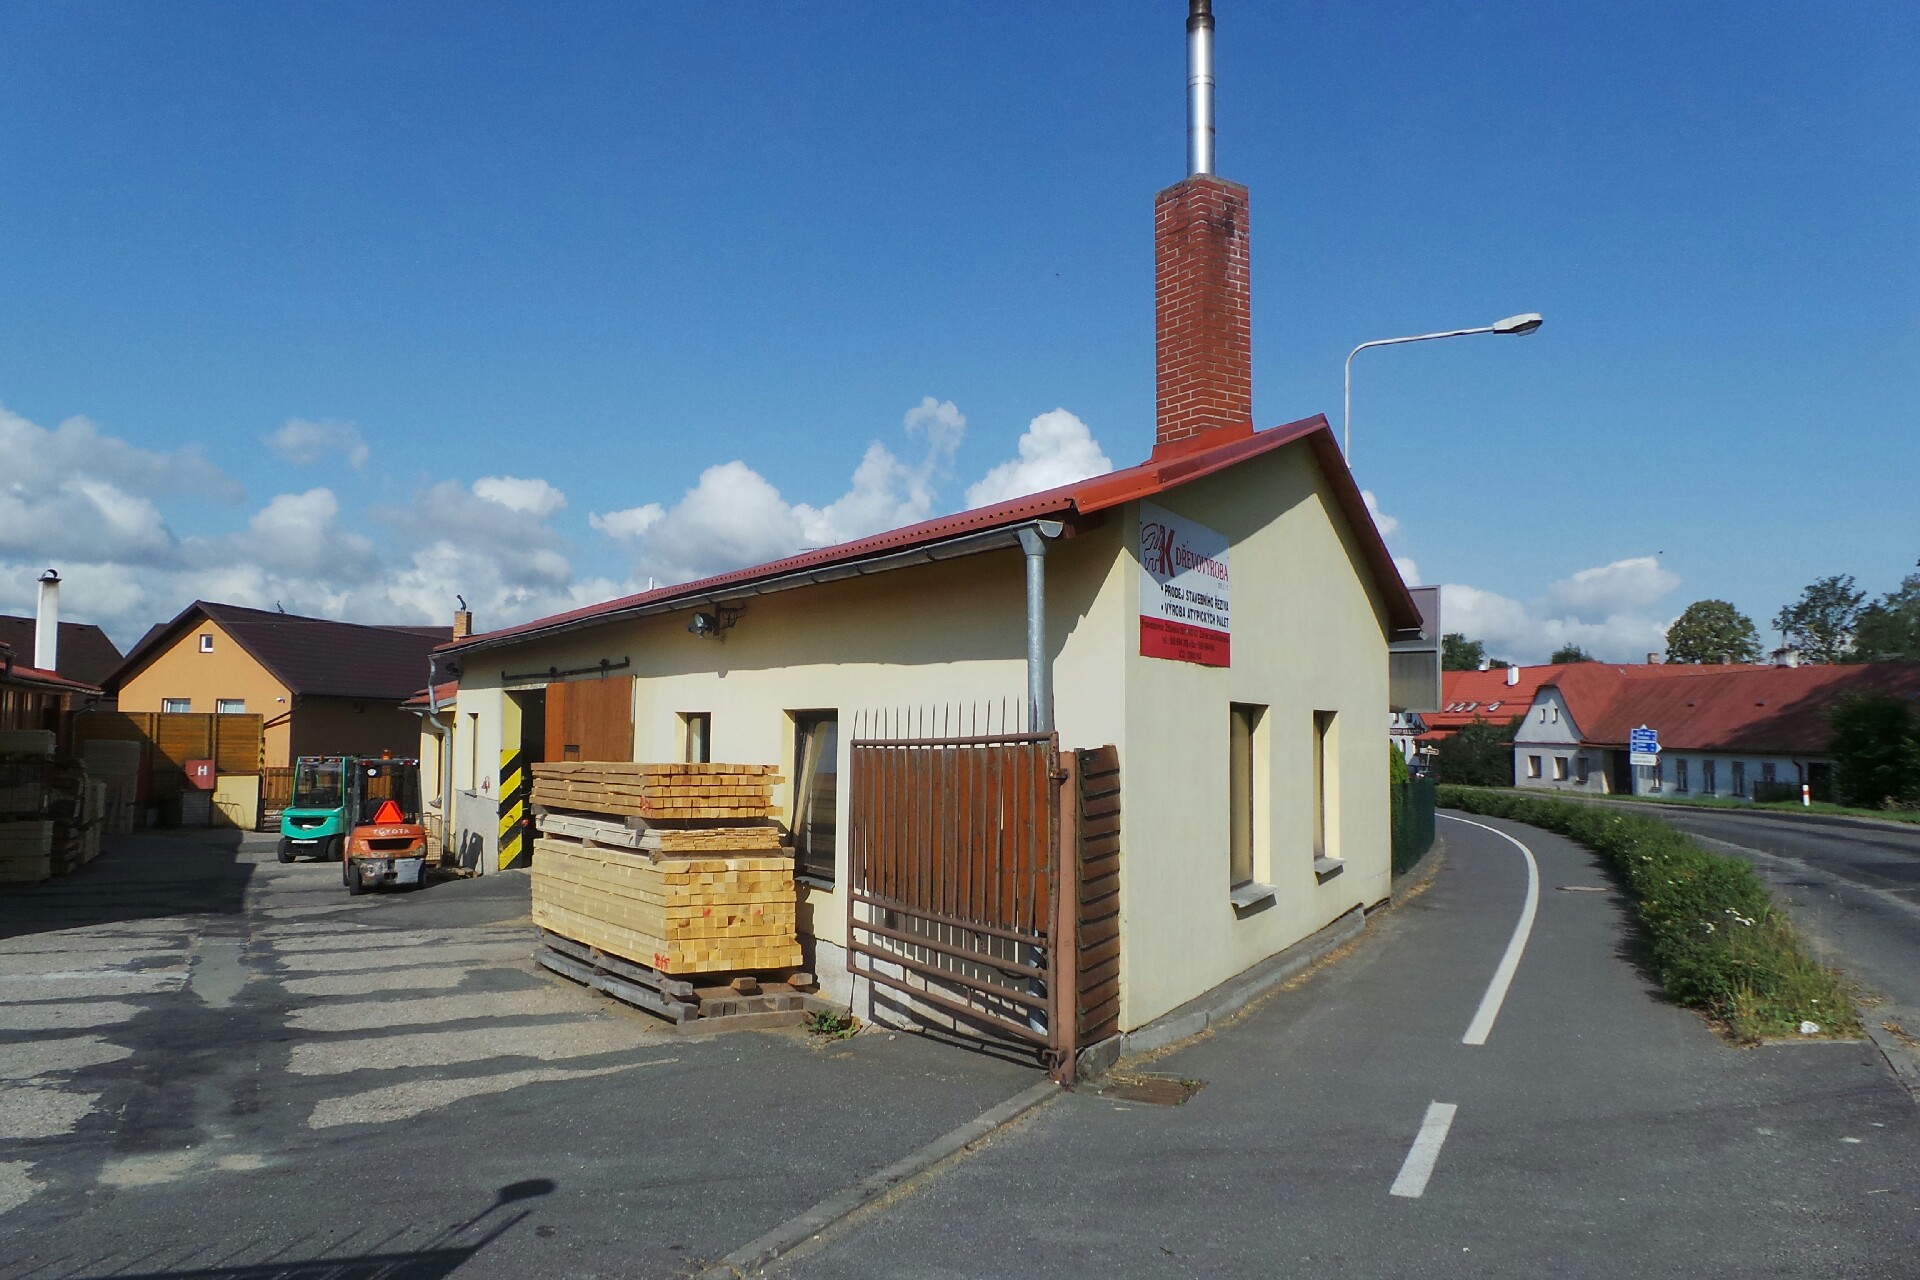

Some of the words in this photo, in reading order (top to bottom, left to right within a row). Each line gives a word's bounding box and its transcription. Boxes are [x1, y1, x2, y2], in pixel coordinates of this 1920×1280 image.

[1176, 542, 1228, 582] DŘEVOVÝROBA
[1164, 584, 1184, 600] PRODEJ
[1186, 590, 1213, 608] STAVEBNÍHO
[1164, 600, 1186, 617] VÝROBA
[1187, 608, 1215, 625] ATYPICKÝCH
[1217, 615, 1229, 628] PALET
[198, 765, 207, 775] H
